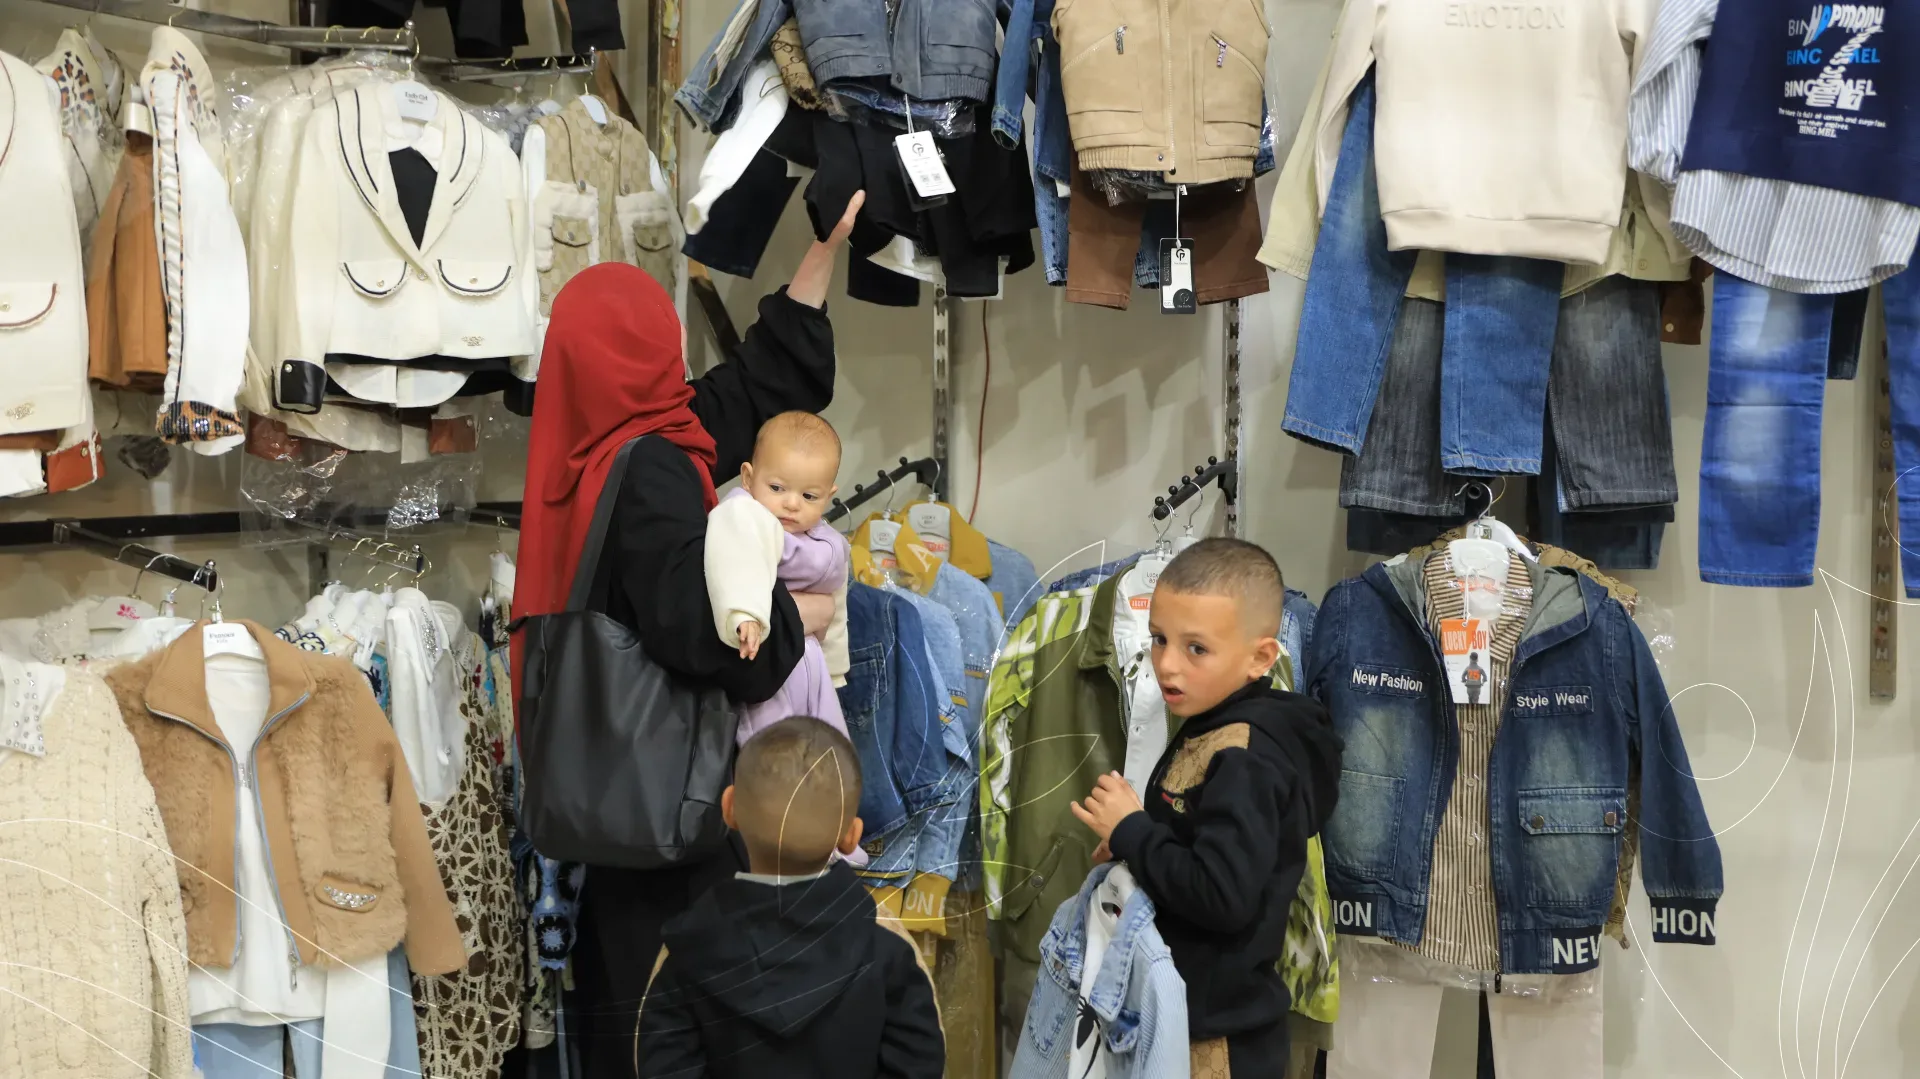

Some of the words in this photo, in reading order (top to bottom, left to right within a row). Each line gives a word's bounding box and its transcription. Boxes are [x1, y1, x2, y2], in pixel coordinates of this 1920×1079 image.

[1444, 4, 1566, 30] EMOTION
[1798, 125, 1817, 136] BING
[1817, 127, 1838, 138] MEL
[1443, 630, 1468, 651] LUCKY
[1471, 630, 1488, 650] BOY
[1352, 668, 1379, 687] New
[1380, 672, 1424, 693] Fashion
[1516, 693, 1550, 710] Style
[1554, 692, 1590, 707] Wear
[1651, 906, 1717, 938] HION
